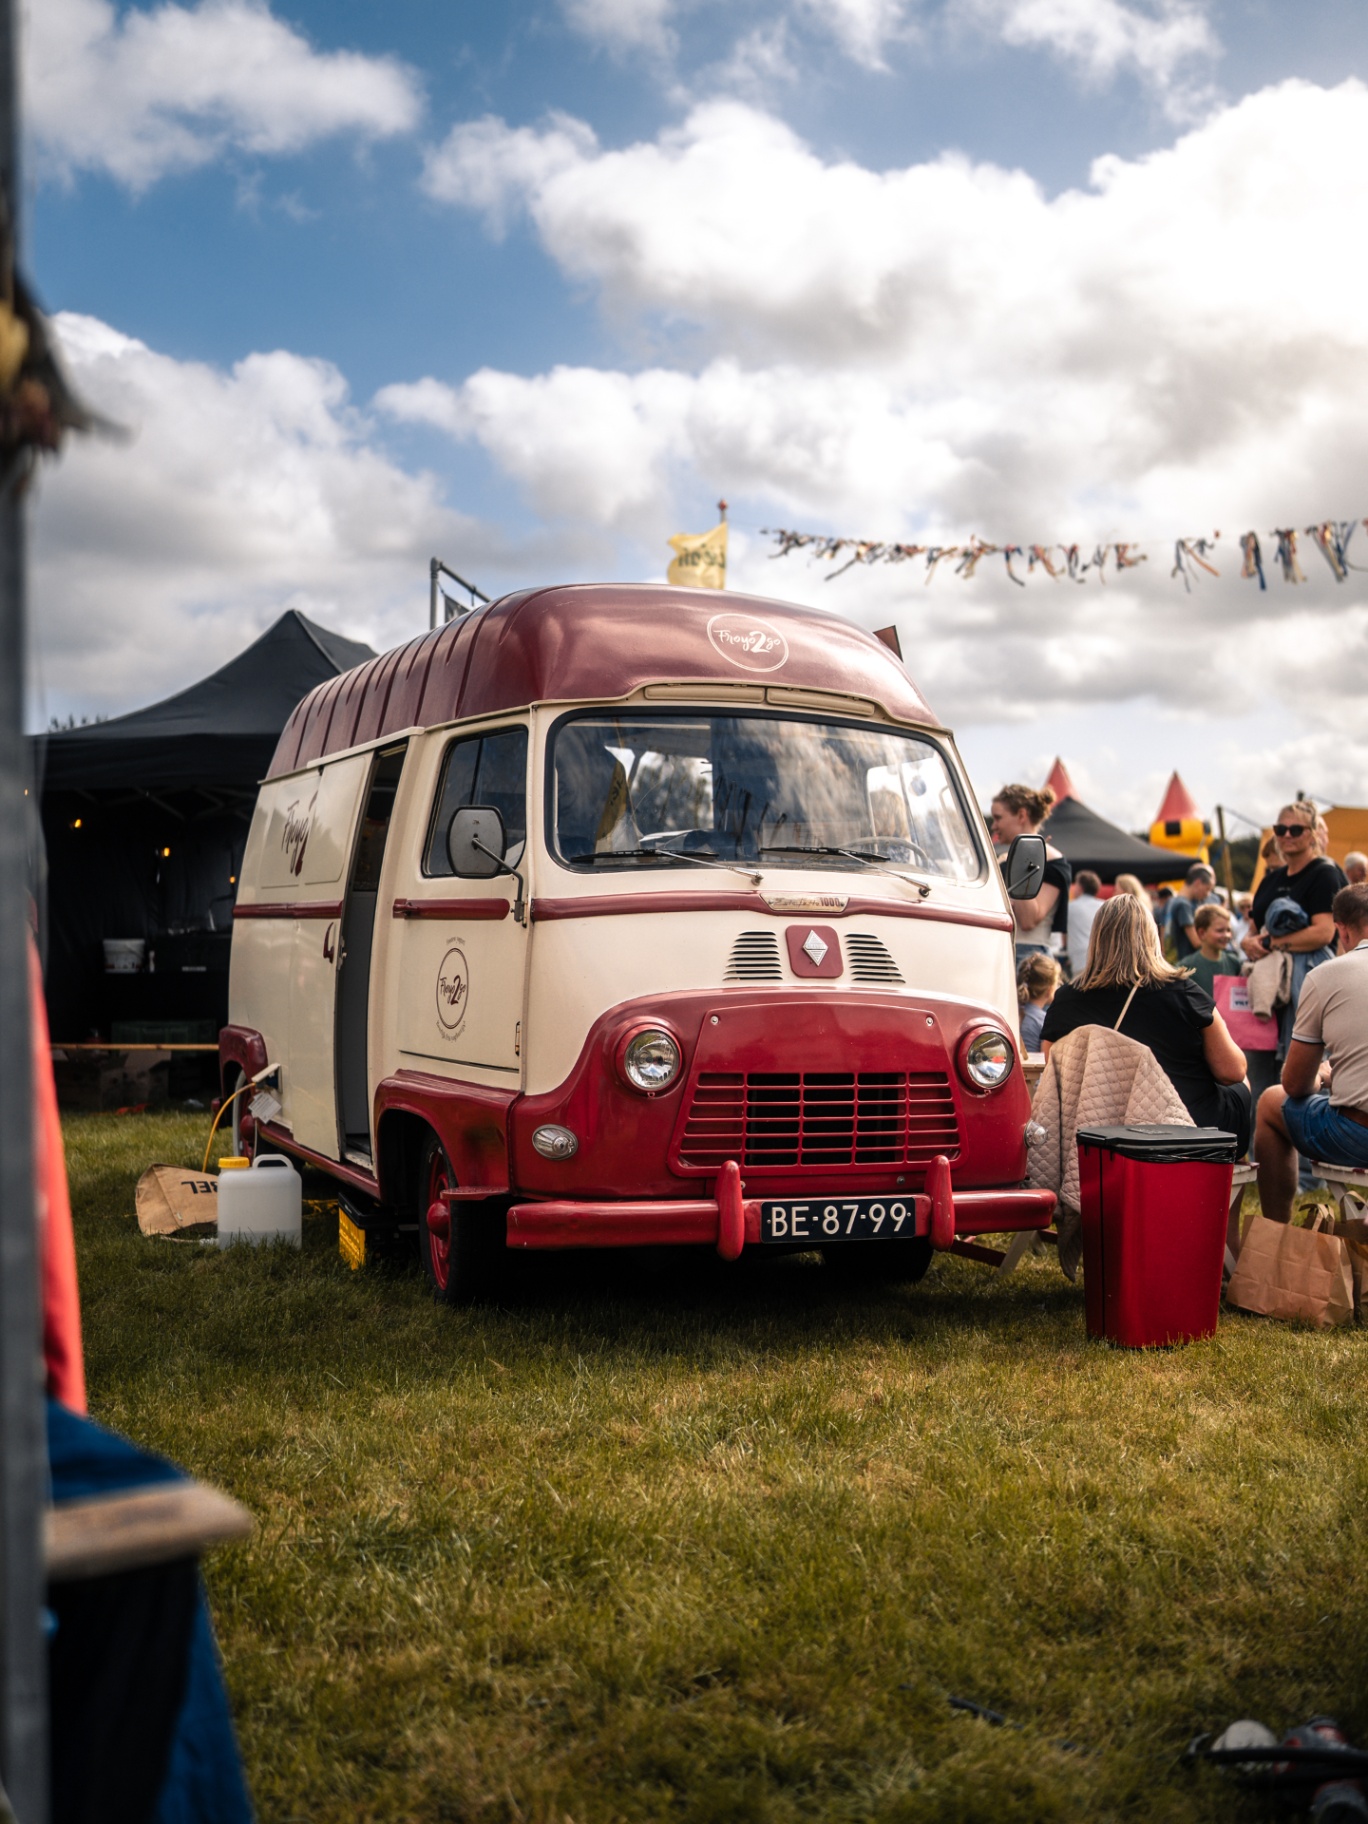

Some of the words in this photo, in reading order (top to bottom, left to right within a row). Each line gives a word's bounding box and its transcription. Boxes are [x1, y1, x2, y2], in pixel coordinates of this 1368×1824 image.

[712, 629, 782, 654] Froyo2go
[820, 897, 841, 907] 1000
[439, 974, 467, 1006] Froyo2go
[771, 1202, 907, 1237] BE-87-99
